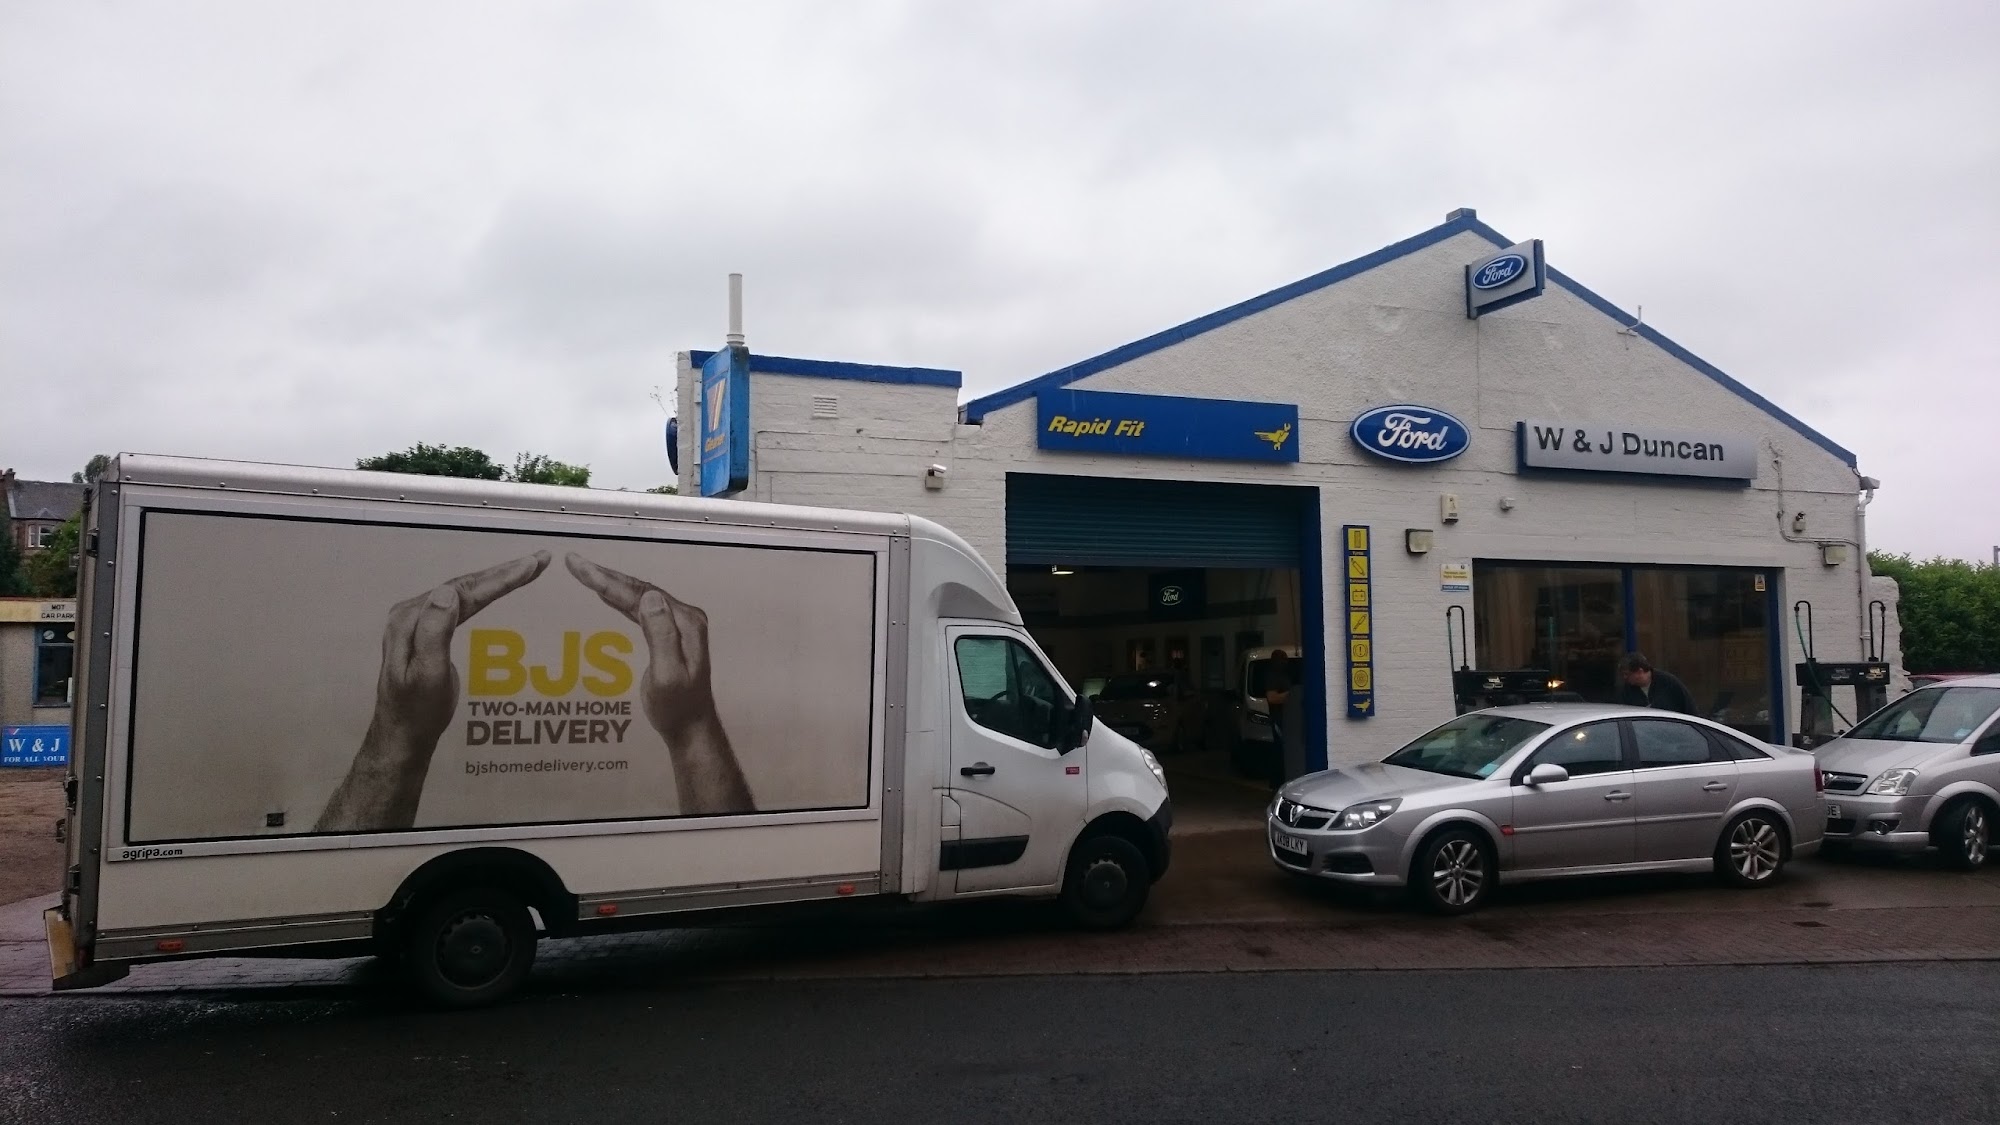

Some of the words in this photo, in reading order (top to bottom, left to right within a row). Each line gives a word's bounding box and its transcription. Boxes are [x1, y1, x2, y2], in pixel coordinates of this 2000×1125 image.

[1482, 260, 1514, 285] Ford
[1048, 415, 1112, 437] Rapid
[1114, 419, 1145, 437] Fit
[1378, 413, 1449, 451] Ford
[1534, 425, 1564, 450] W
[1573, 429, 1592, 453] &
[1599, 431, 1613, 455] J
[1622, 432, 1724, 462] Duncan
[1162, 588, 1179, 602] Ford
[468, 629, 634, 697] BJS
[468, 701, 571, 716] TWO-MAN
[576, 701, 632, 716] HOME
[466, 719, 632, 746] DELIVERY
[8, 738, 26, 752] W
[32, 738, 44, 752] &
[50, 738, 60, 752] J
[465, 759, 629, 776] bjshomedelivery.com
[122, 848, 183, 860] agripa.com
